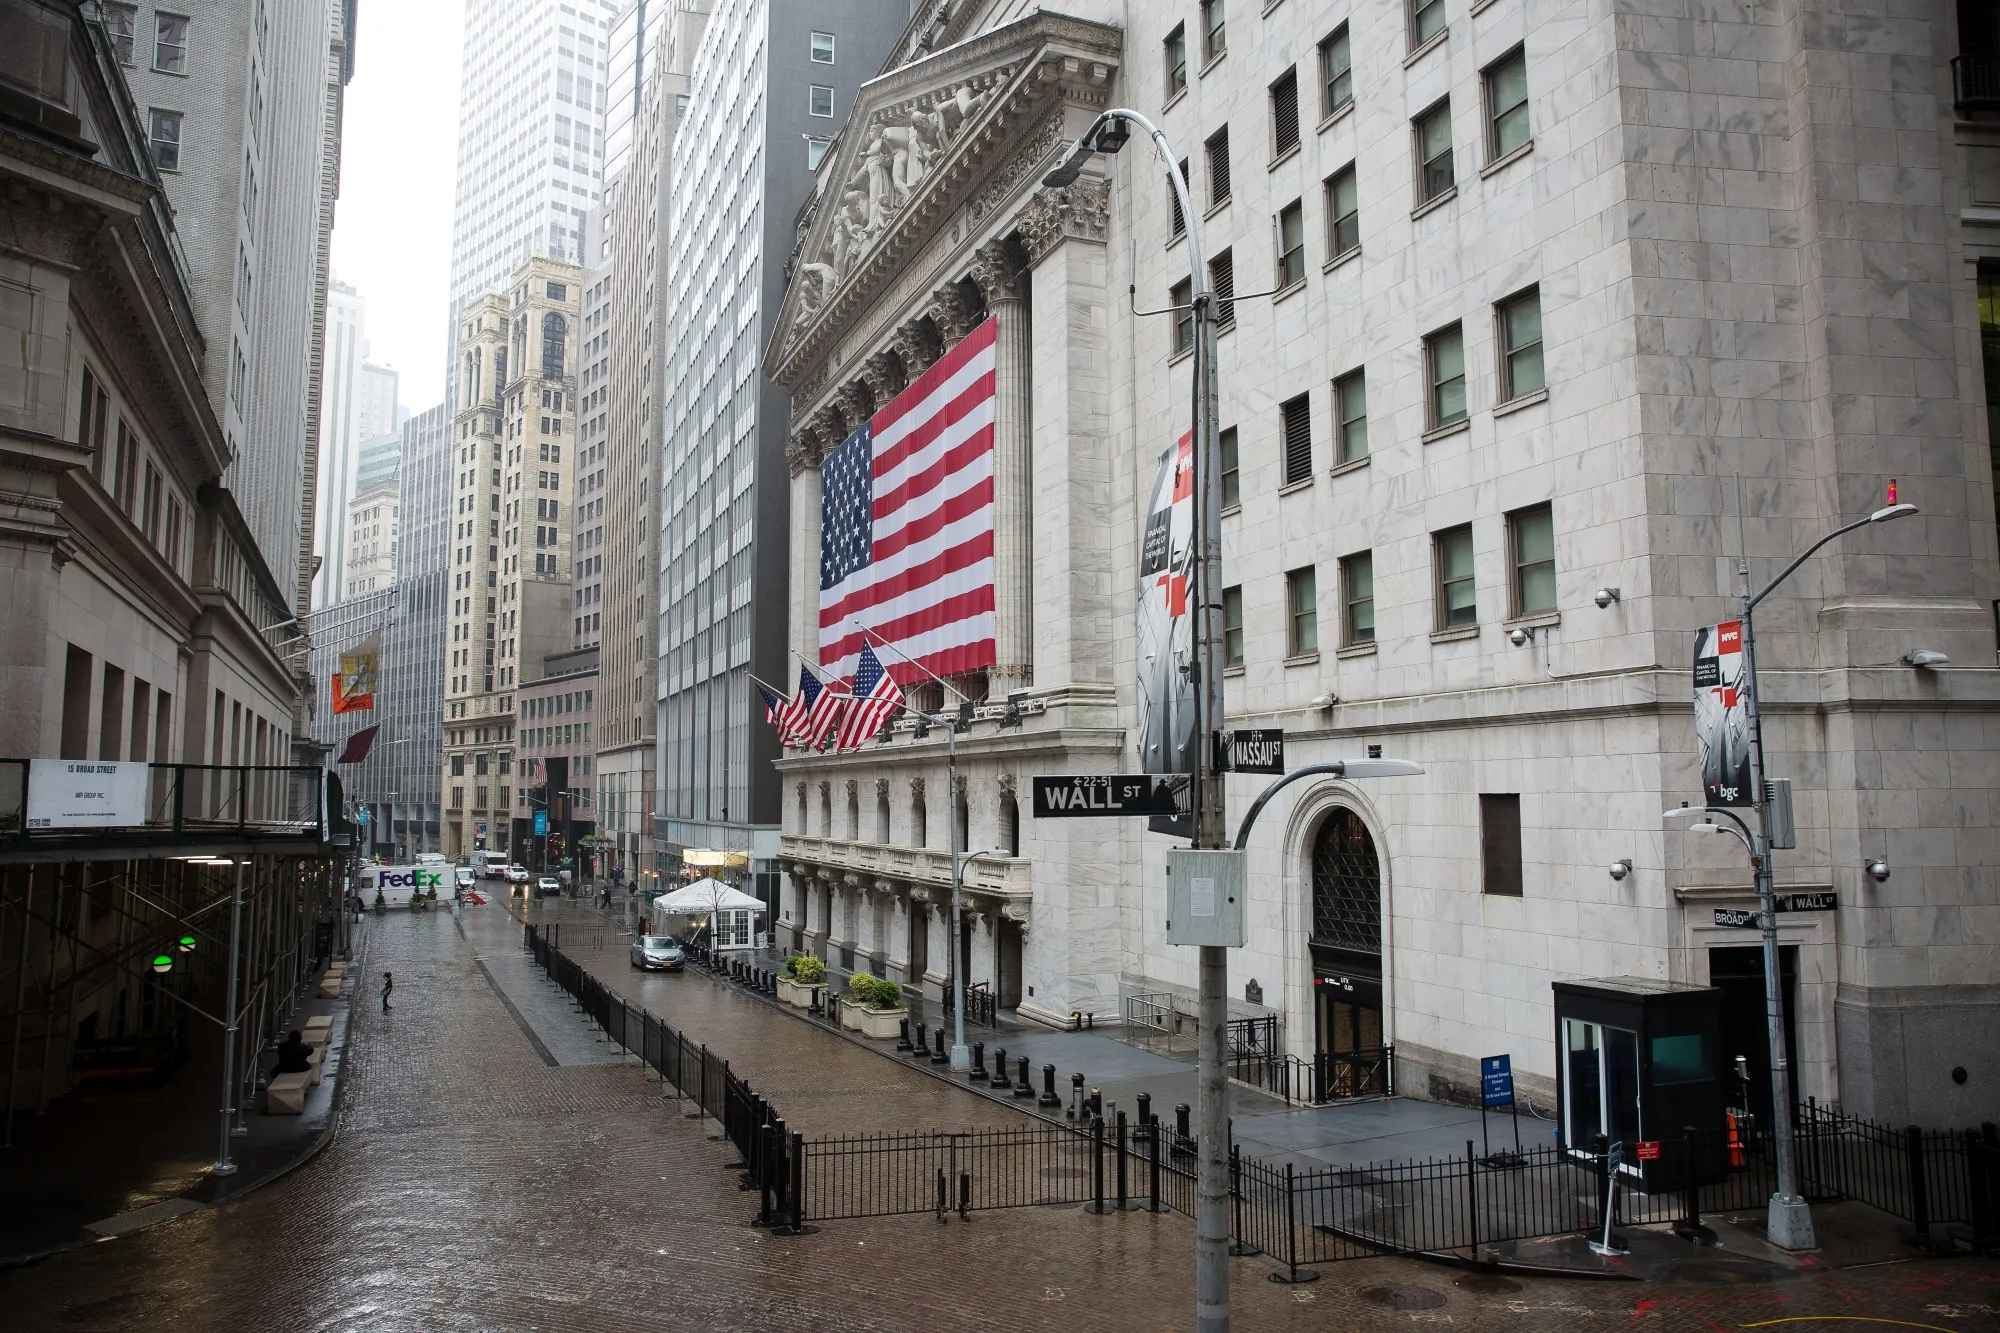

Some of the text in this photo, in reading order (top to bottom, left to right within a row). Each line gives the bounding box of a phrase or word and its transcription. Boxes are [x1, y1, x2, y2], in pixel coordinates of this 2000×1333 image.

[1147, 524, 1167, 538] FINANCIAL
[1721, 631, 1738, 642] NYC
[1236, 741, 1281, 766] NASSAU ST
[68, 764, 116, 774] 15 BROAD STREET
[1083, 776, 1112, 787] 22-51
[1045, 785, 1141, 809] WALL ST
[1720, 783, 1739, 801] bgc
[379, 869, 442, 887] FedEx
[1796, 897, 1827, 909] WALL
[1715, 912, 1744, 925] BROAD
